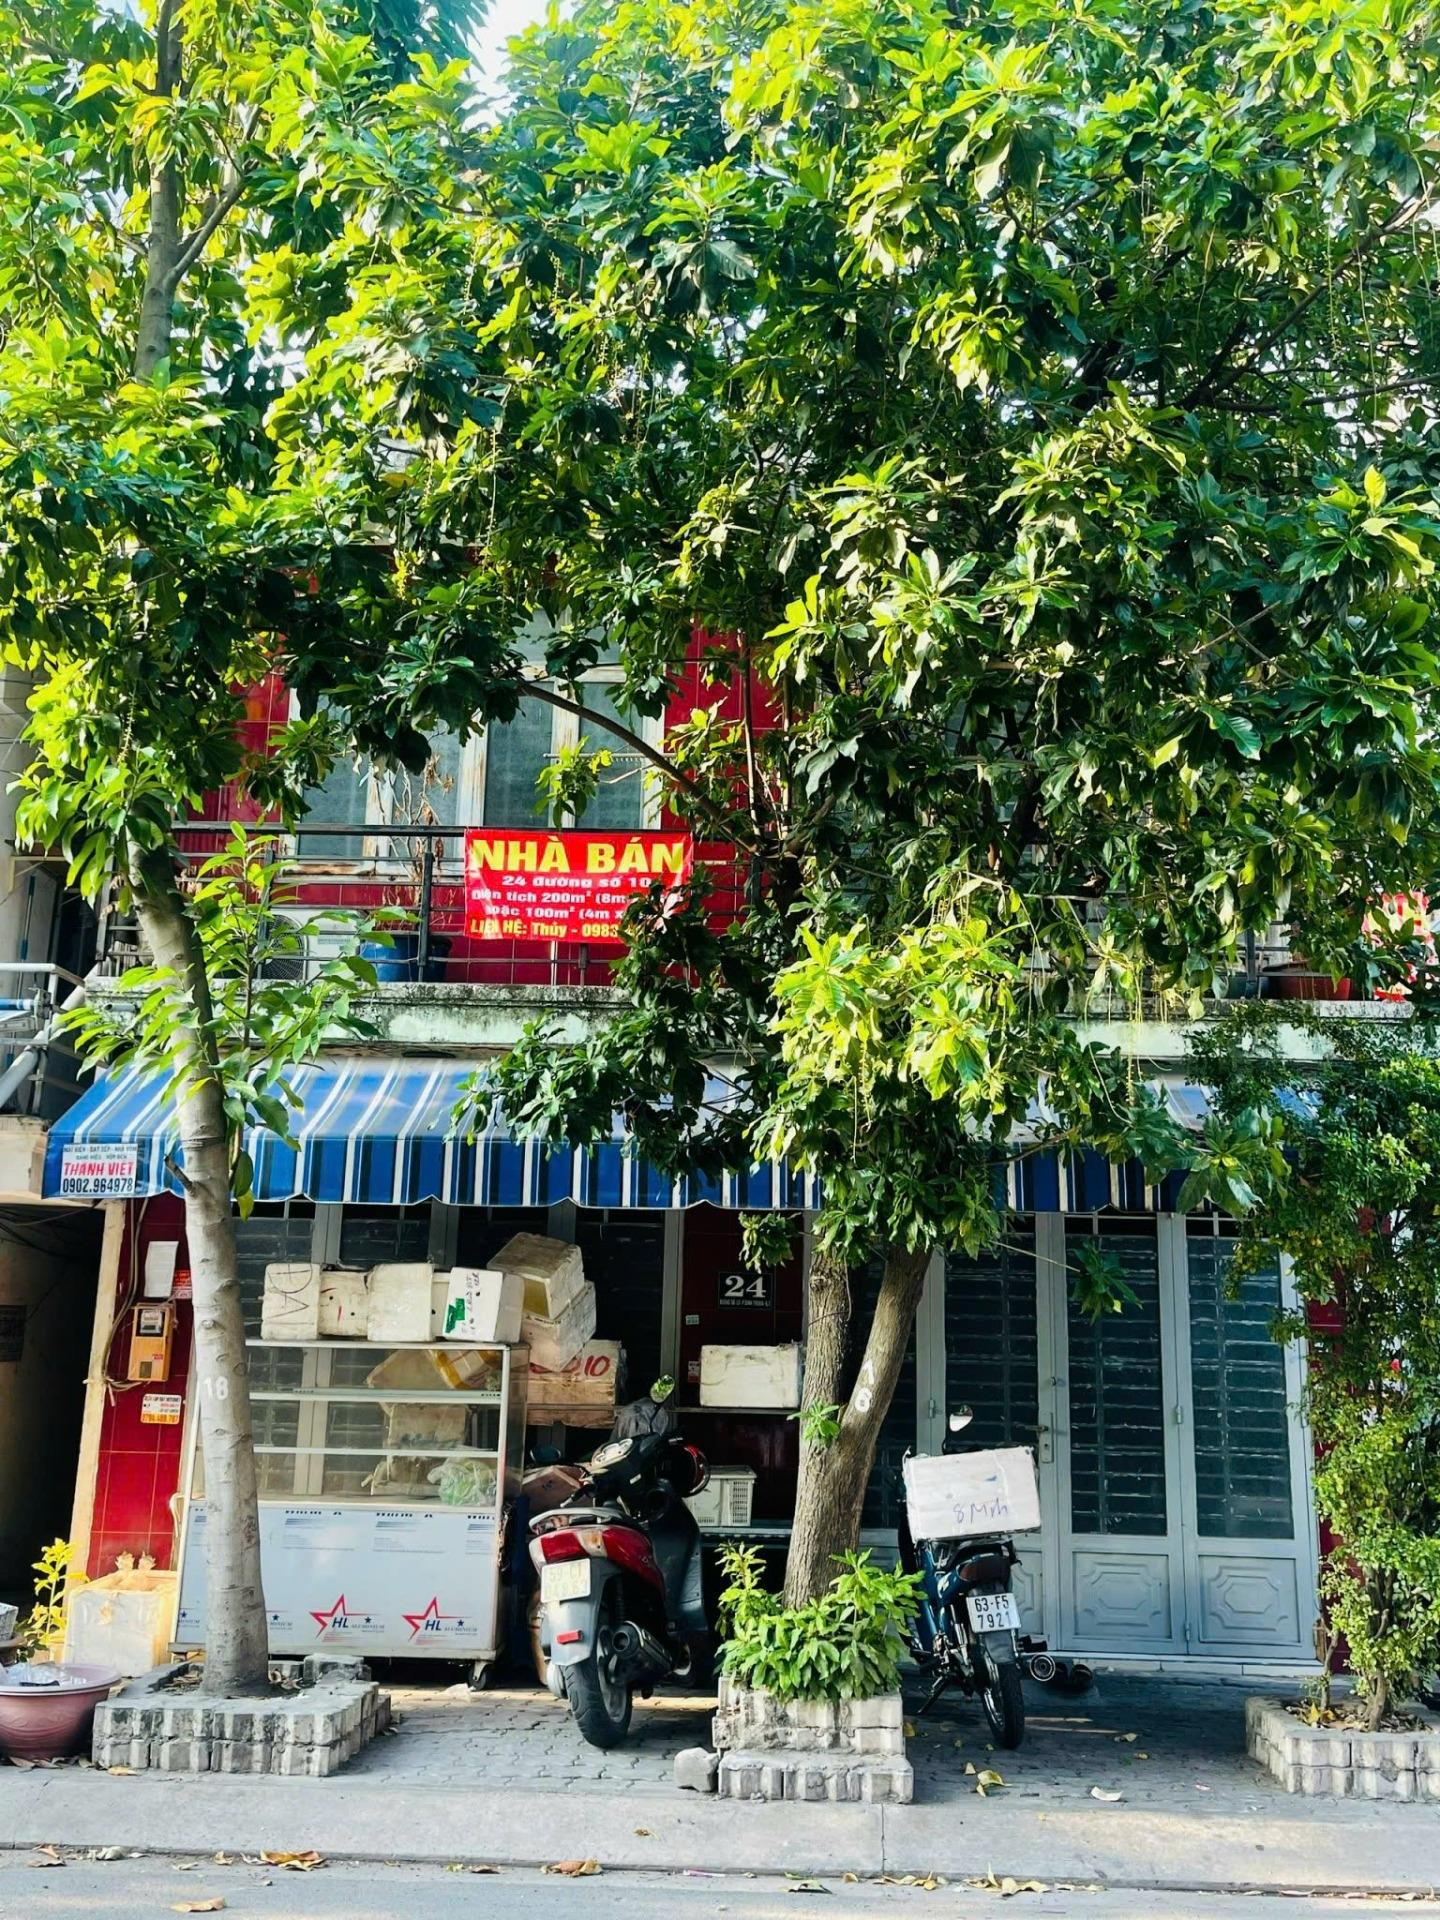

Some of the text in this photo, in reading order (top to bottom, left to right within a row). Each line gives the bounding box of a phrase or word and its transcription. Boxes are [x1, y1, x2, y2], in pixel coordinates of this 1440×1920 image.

[470, 835, 684, 874] NHÀ BÁN
[502, 875, 527, 886] 24
[599, 875, 622, 888] số
[471, 888, 502, 900] Dn
[506, 891, 537, 903] tích
[485, 904, 520, 917] oặc
[470, 918, 500, 933] LI
[62, 1178, 133, 1193] 0902.964978
[725, 1275, 766, 1297] 24
[203, 1376, 229, 1400] 18
[332, 1617, 349, 1628] HL
[425, 1620, 442, 1631] HL
[977, 1611, 1012, 1629] 7921
